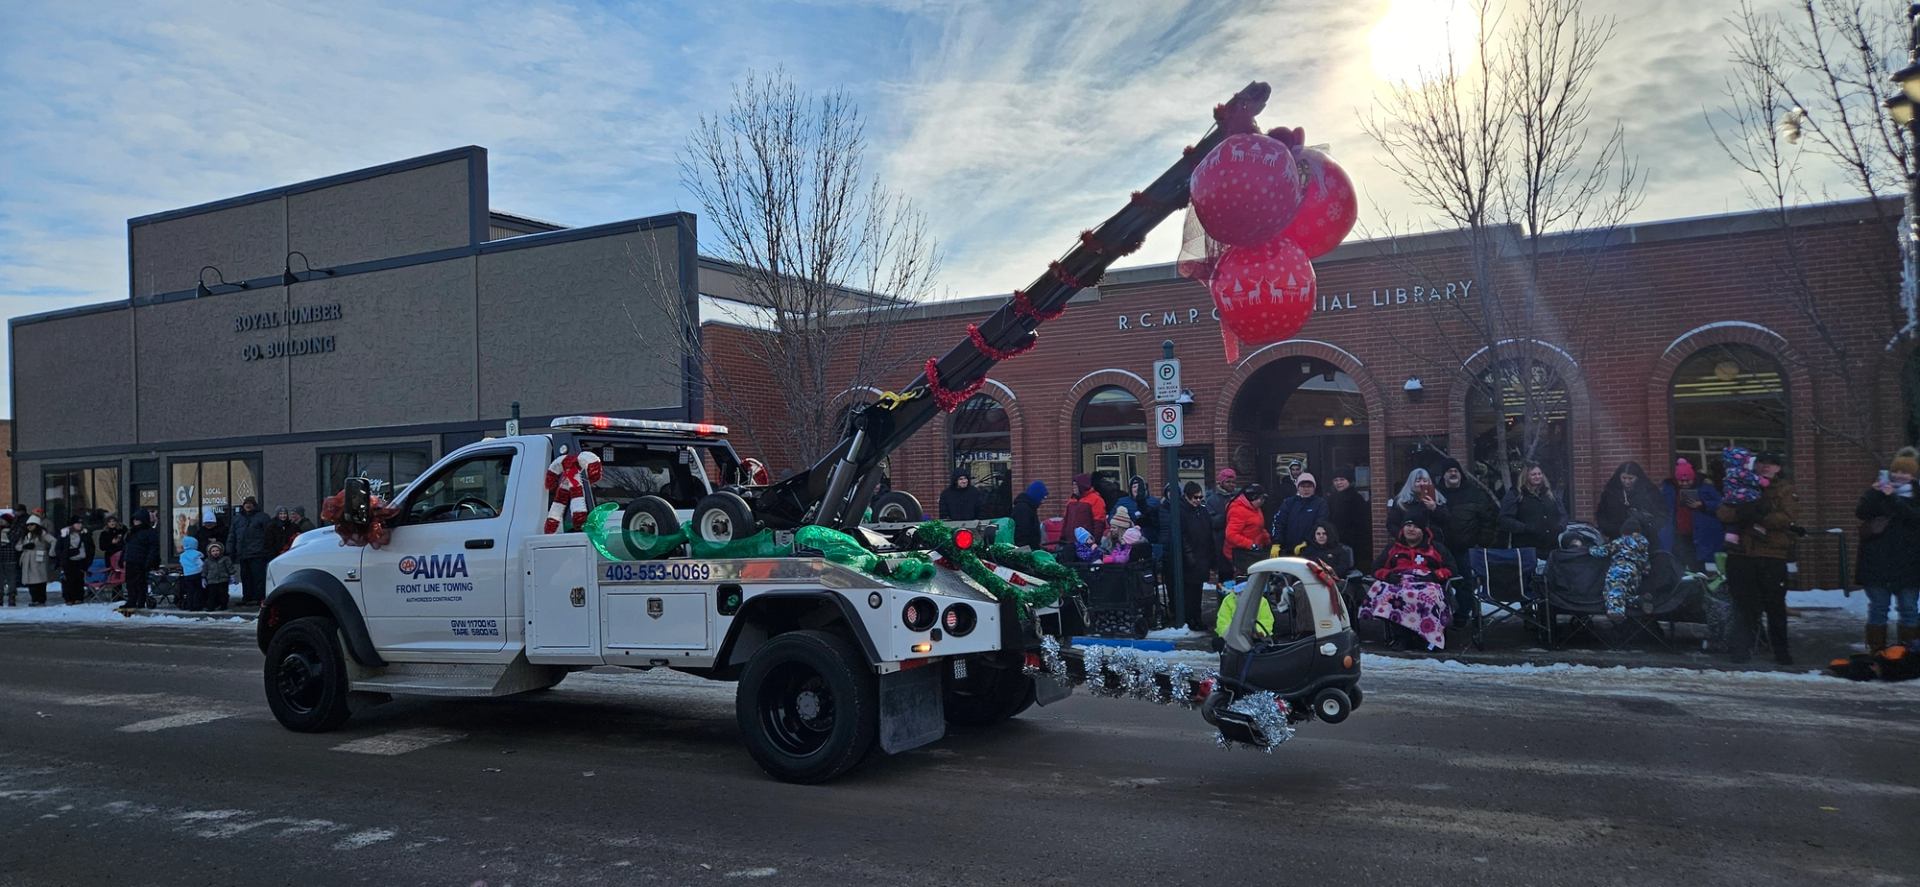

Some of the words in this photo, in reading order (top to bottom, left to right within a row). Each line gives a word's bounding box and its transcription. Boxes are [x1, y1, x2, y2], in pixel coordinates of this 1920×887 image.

[1373, 279, 1473, 306] LIBRARY
[233, 311, 280, 333] ROYAL
[281, 303, 343, 326] LUMBER
[242, 343, 265, 361] CO.
[266, 335, 336, 359] BUILDING
[205, 487, 222, 495] LOCAL
[202, 496, 228, 505] BOUTIQUE
[413, 554, 468, 579] AMA
[606, 563, 710, 581] 403-553-0069
[396, 584, 421, 594] FRONT
[423, 583, 441, 593] LINE
[443, 582, 473, 592] TOWING
[450, 619, 467, 628] GVW
[467, 619, 486, 628] 11700
[486, 619, 497, 628] KG
[488, 628, 499, 636] KG
